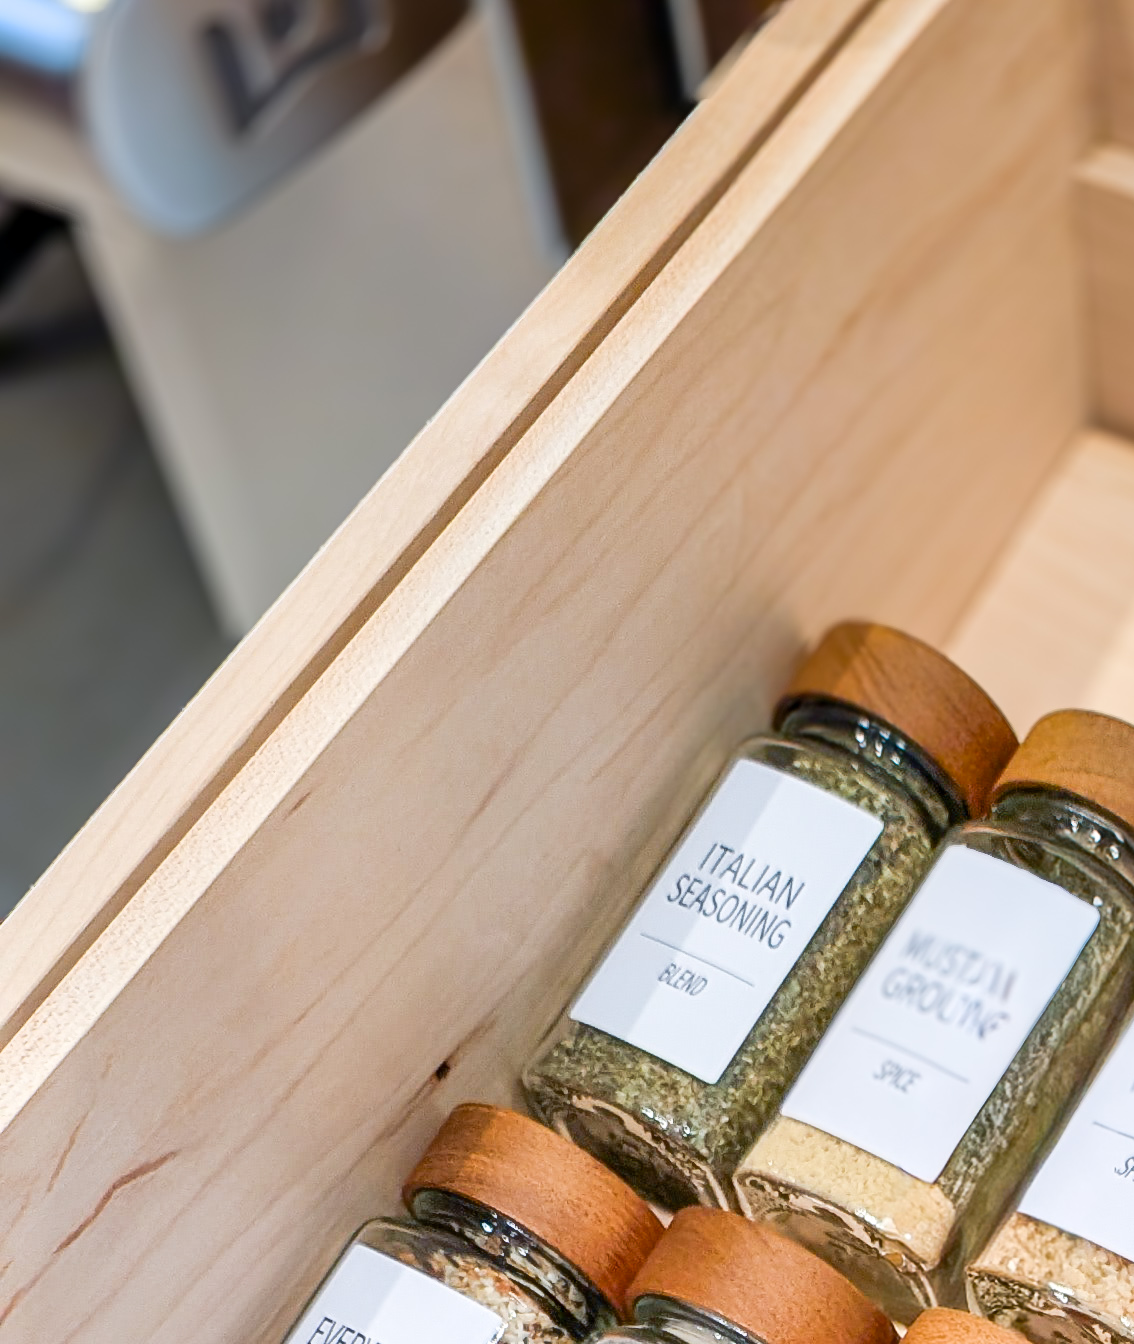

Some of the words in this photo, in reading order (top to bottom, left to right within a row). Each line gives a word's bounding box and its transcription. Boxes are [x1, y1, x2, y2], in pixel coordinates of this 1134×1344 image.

[699, 842, 805, 908] ITALIAN
[667, 875, 792, 950] SEASONING
[658, 964, 707, 996] BLEND
[873, 1061, 922, 1094] SPICE
